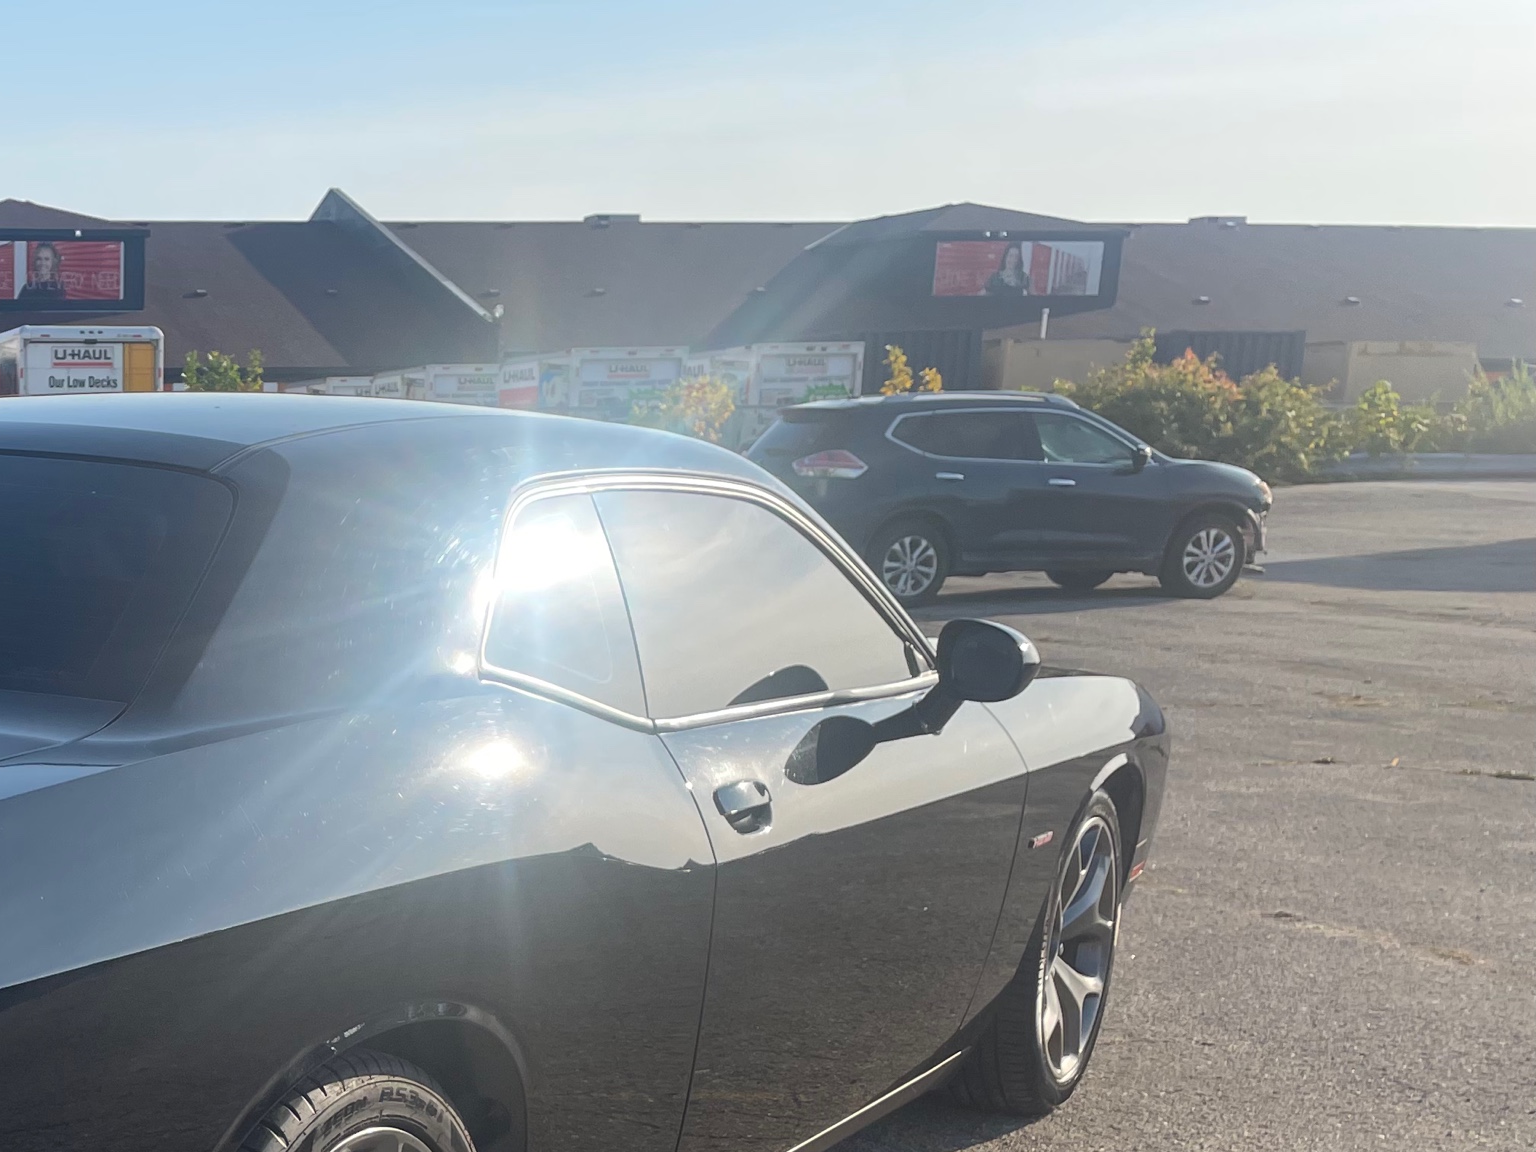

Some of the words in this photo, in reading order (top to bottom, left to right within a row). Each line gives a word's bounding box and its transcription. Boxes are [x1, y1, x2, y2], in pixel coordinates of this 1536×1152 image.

[54, 349, 111, 360] U-HAUL
[49, 375, 65, 388] Our
[67, 375, 85, 388] Low
[88, 376, 117, 388] Decks
